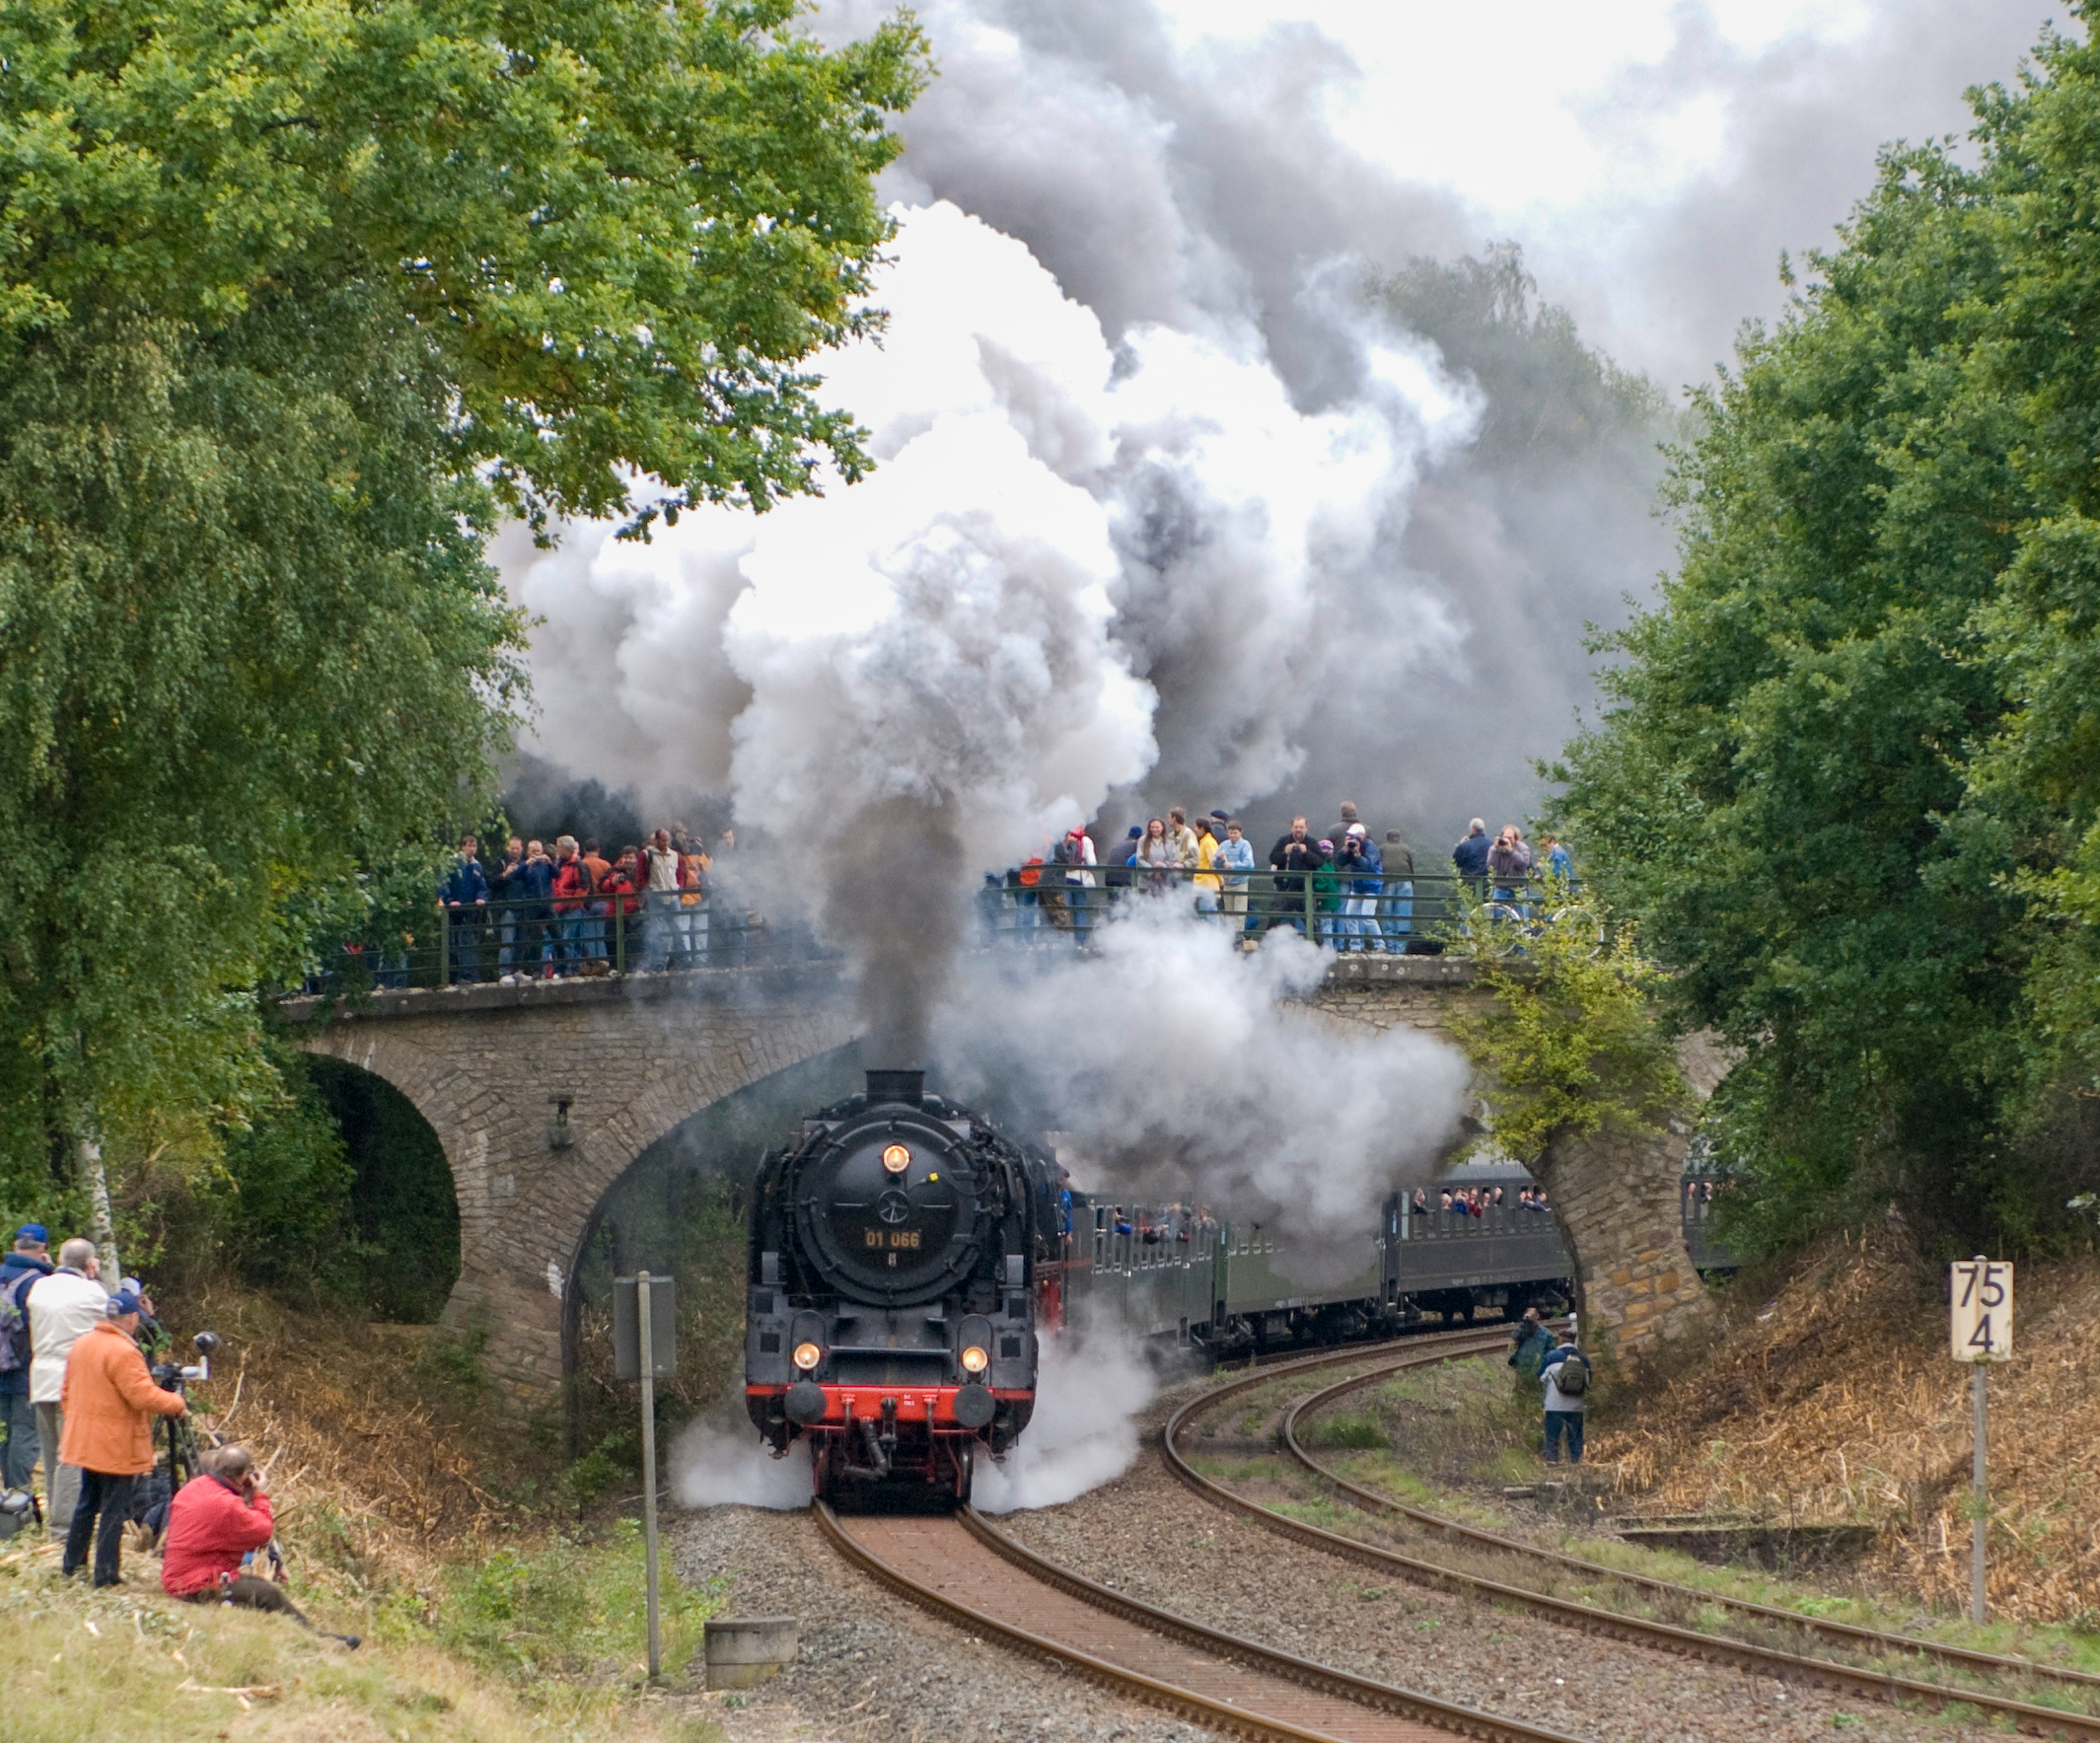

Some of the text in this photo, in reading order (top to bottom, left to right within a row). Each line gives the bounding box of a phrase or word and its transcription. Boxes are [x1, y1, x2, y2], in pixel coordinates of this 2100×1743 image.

[866, 1231, 920, 1248] 01 066
[1958, 1265, 2006, 1308] 75
[1968, 1313, 1994, 1353] 4
